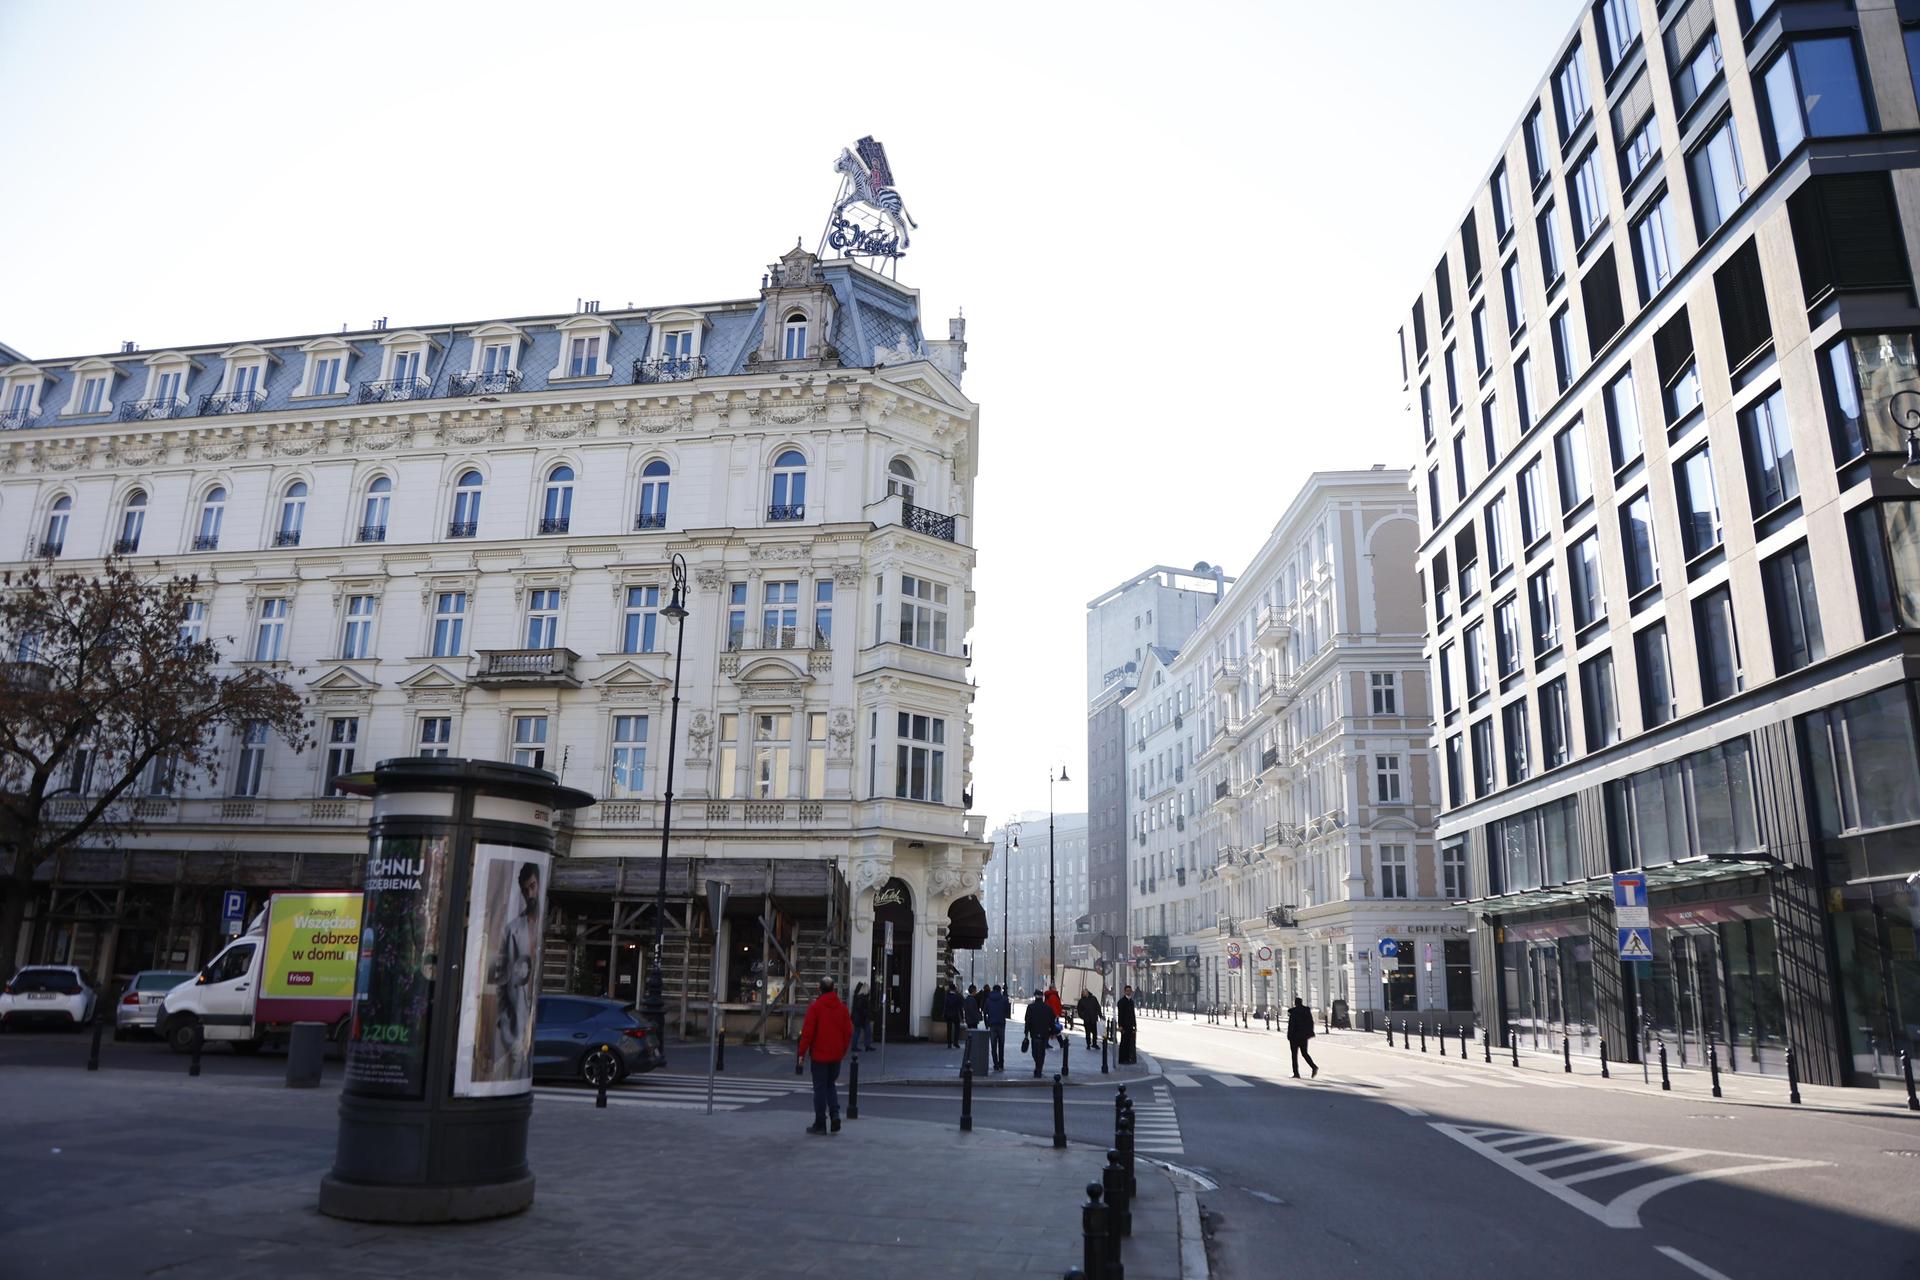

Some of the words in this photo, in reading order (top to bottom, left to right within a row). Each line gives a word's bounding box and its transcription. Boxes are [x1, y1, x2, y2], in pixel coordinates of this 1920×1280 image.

[228, 894, 241, 916] P
[295, 916, 357, 931] Wszędzie
[312, 932, 358, 944] dobrze
[293, 950, 304, 960] w
[307, 947, 344, 960] domu
[289, 973, 311, 982] frisco
